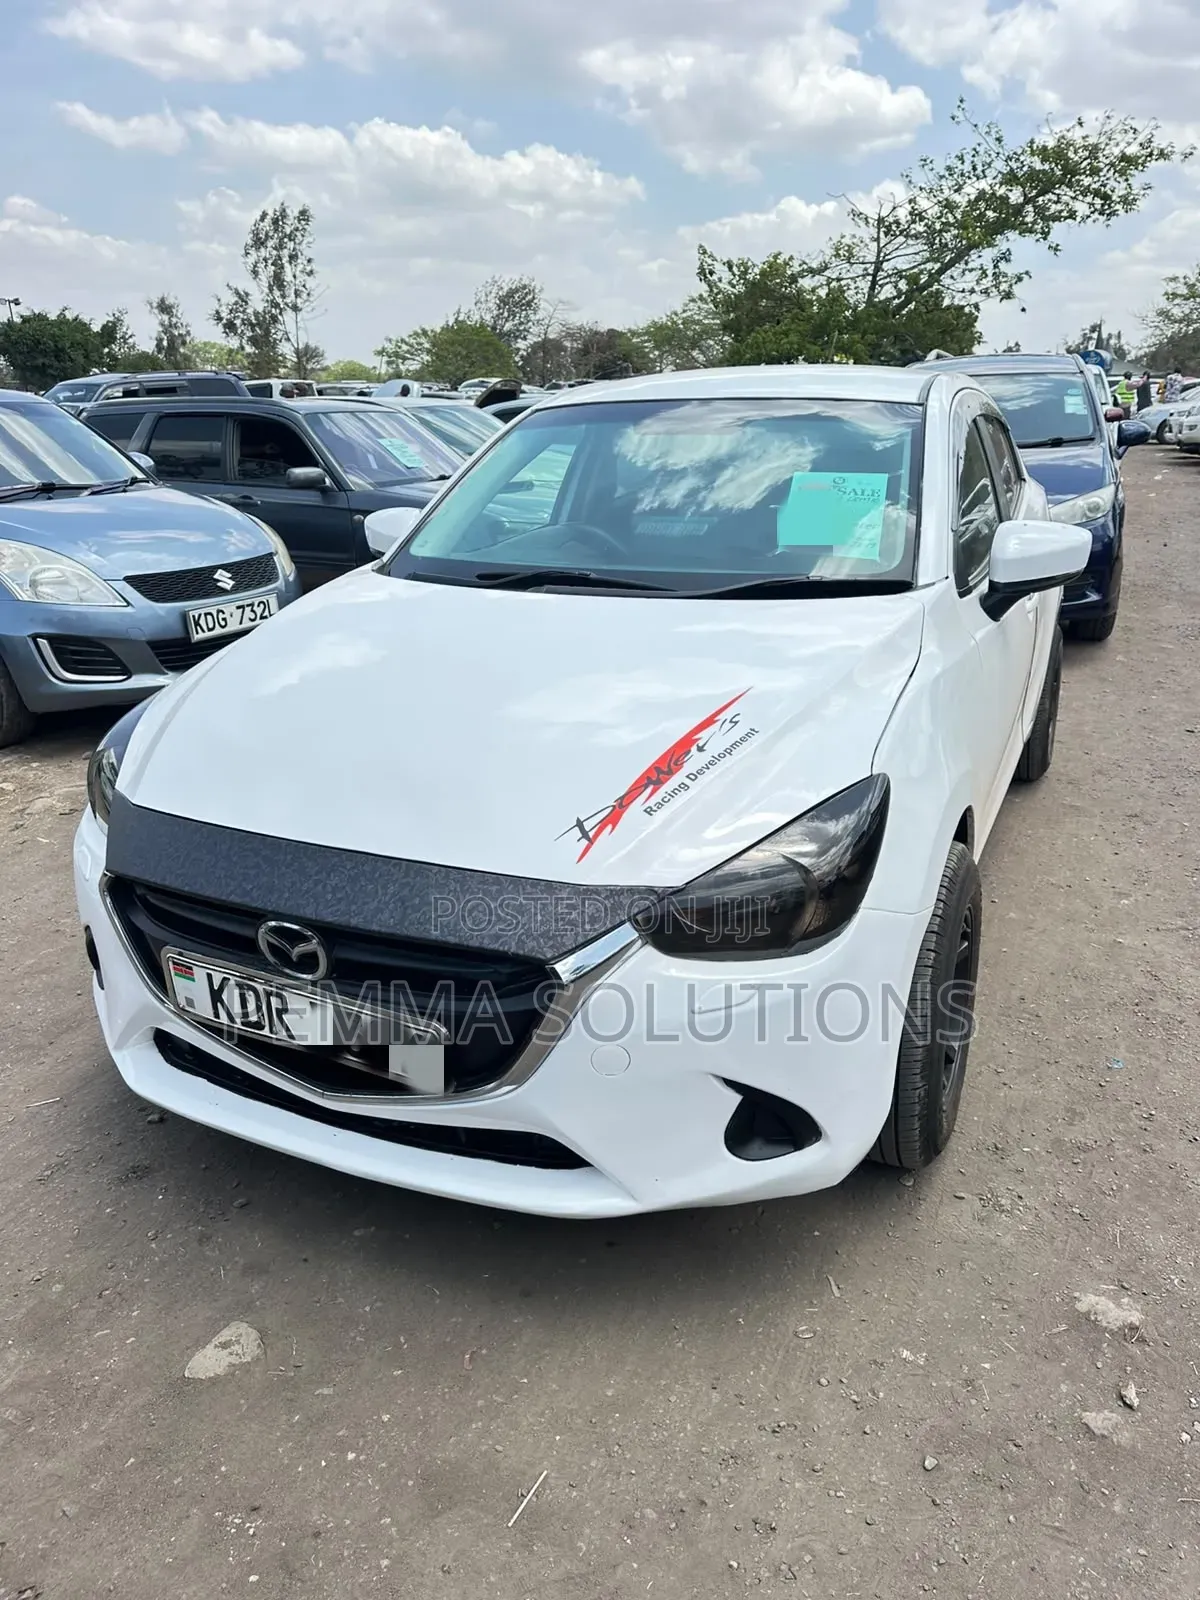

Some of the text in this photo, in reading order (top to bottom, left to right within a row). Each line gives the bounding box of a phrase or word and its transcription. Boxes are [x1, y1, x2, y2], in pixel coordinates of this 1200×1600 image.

[836, 487, 881, 497] SALE
[191, 608, 228, 635] KDG
[643, 727, 760, 816] Racing Development
[206, 972, 296, 1041] KDR
